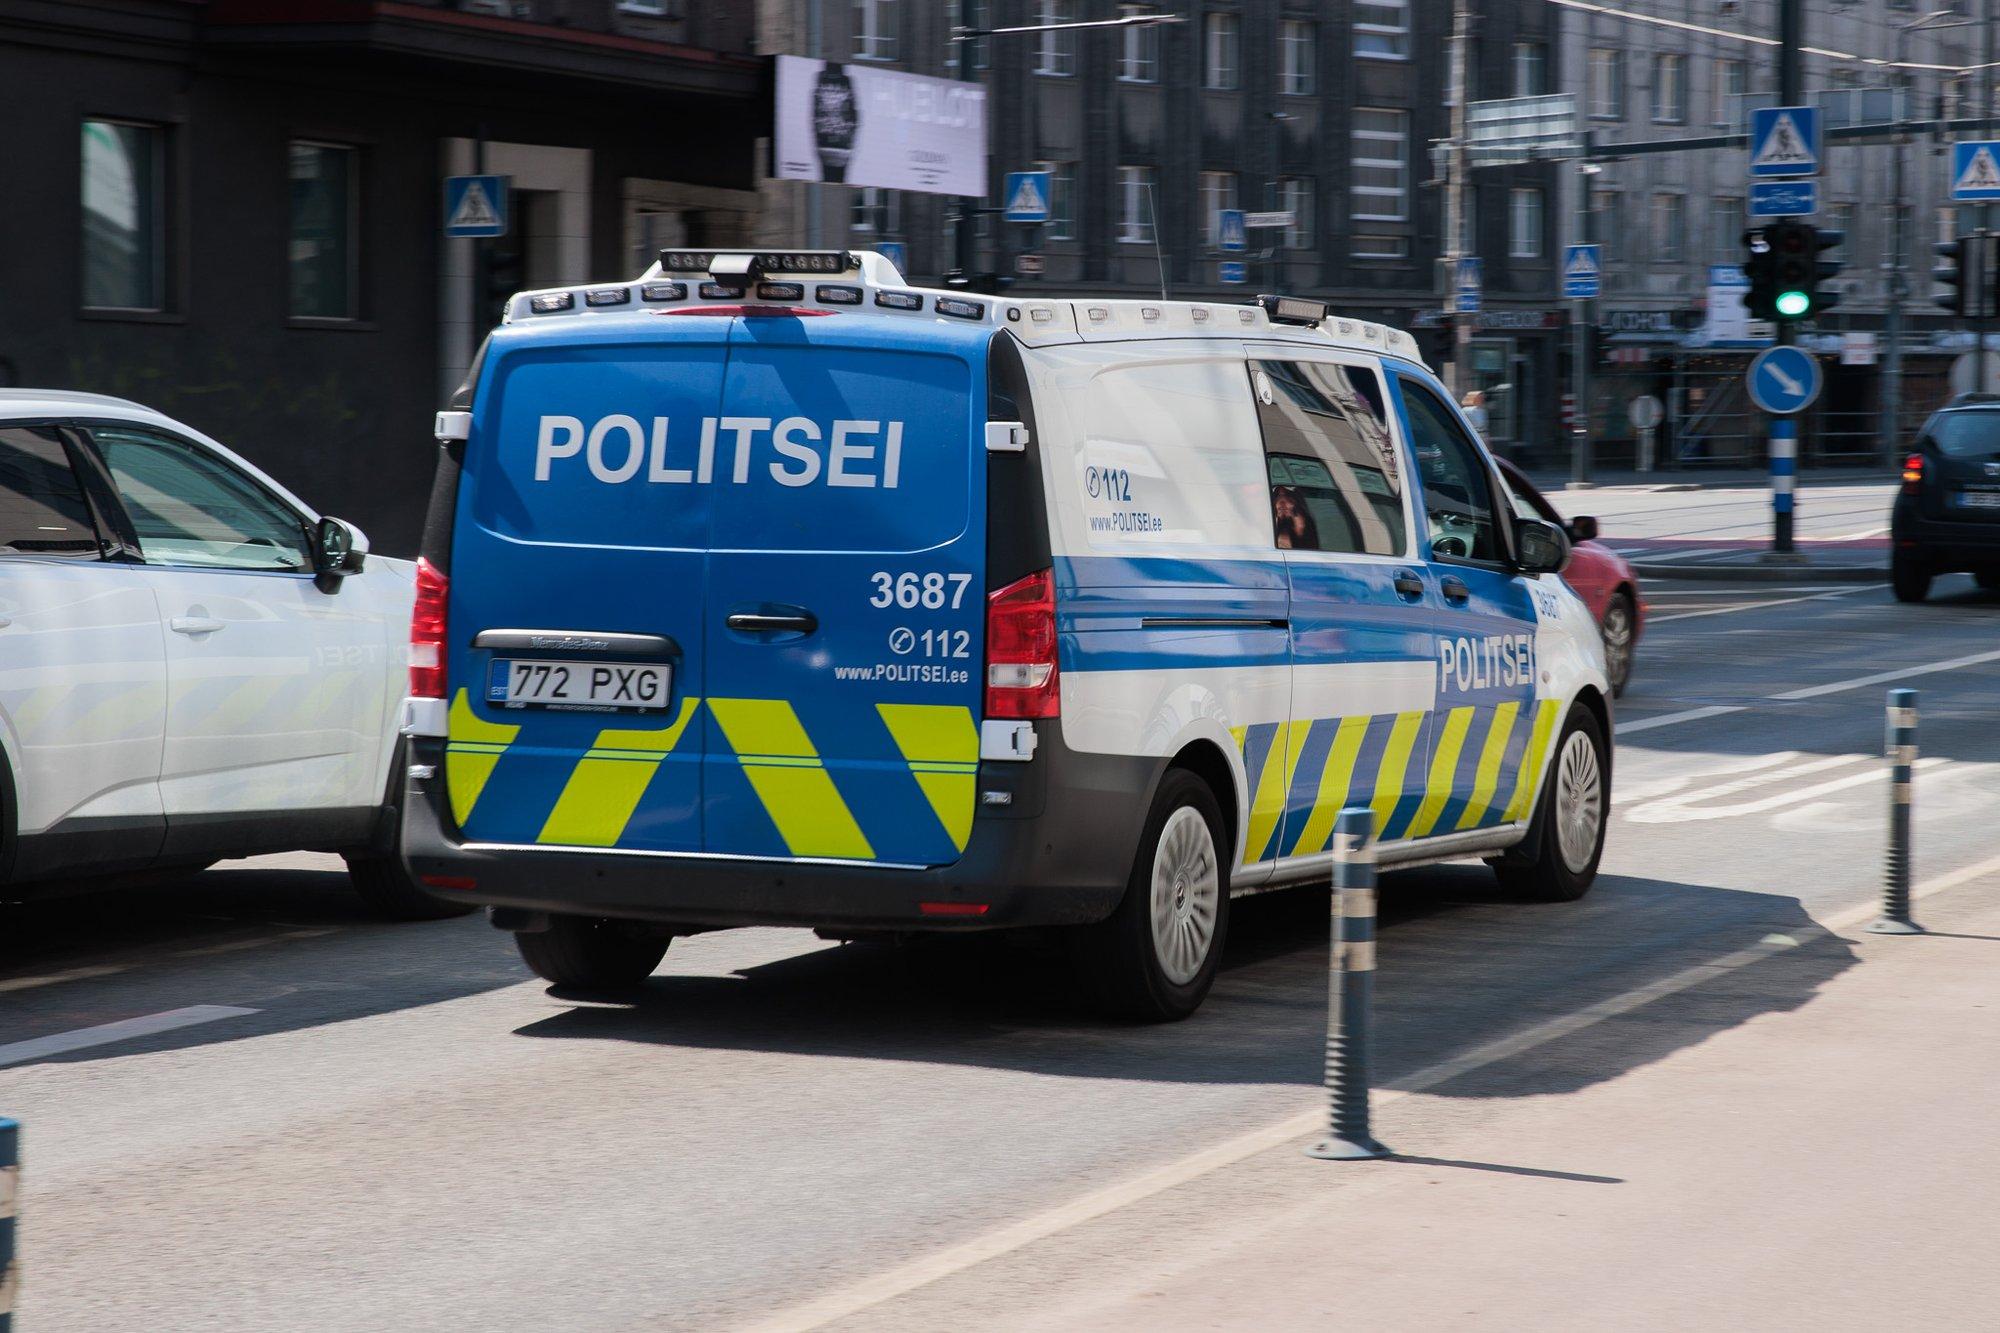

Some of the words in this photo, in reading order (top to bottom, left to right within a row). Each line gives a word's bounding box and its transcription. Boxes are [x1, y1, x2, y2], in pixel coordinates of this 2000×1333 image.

[534, 414, 903, 489] POLITSEI
[1102, 468, 1132, 501] 112
[1089, 513, 1162, 532] www.POLITSEI.ee
[869, 571, 972, 609] 3687
[920, 629, 970, 658] 112
[834, 664, 968, 683] www.POLITSEI.ee
[1439, 633, 1533, 692] POLITSEI
[514, 665, 570, 698] 772
[590, 668, 658, 701] PXG
